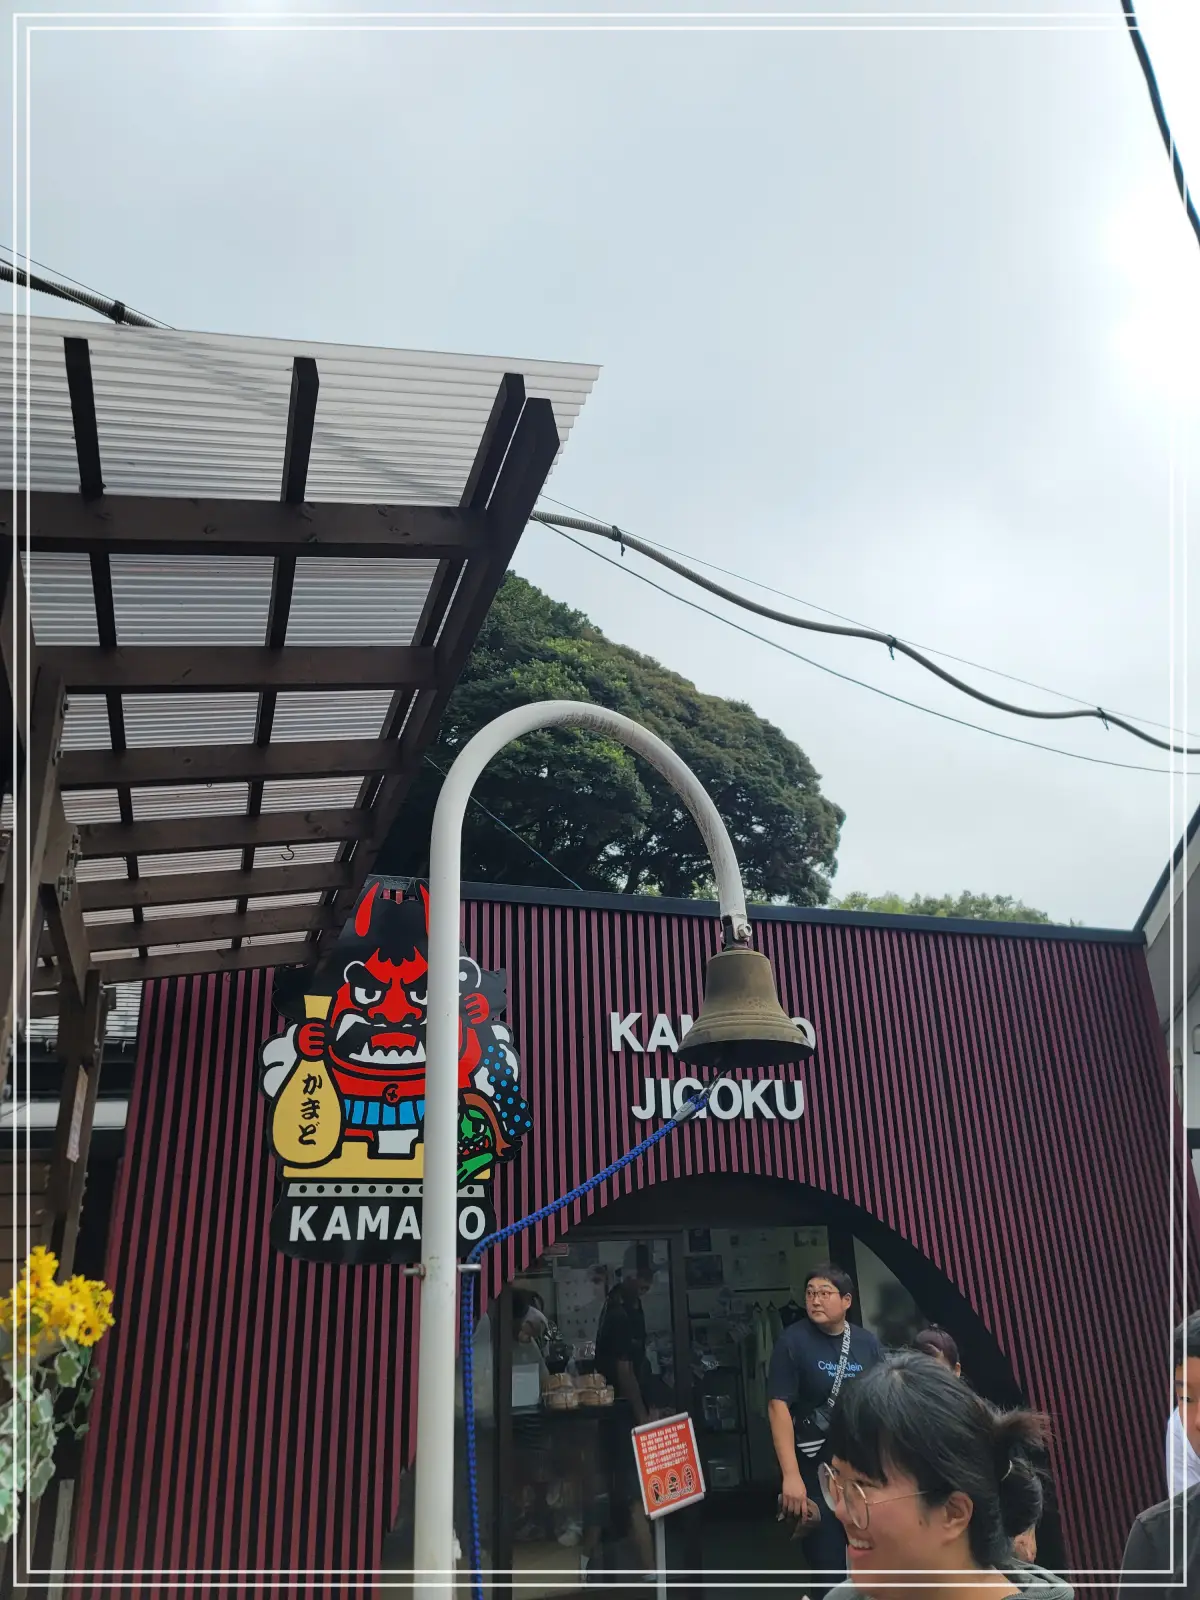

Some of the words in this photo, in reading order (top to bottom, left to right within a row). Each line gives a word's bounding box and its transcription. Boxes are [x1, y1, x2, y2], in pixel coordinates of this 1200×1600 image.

[298, 1073, 322, 1145] かまど
[289, 1205, 486, 1242] KAMAO
